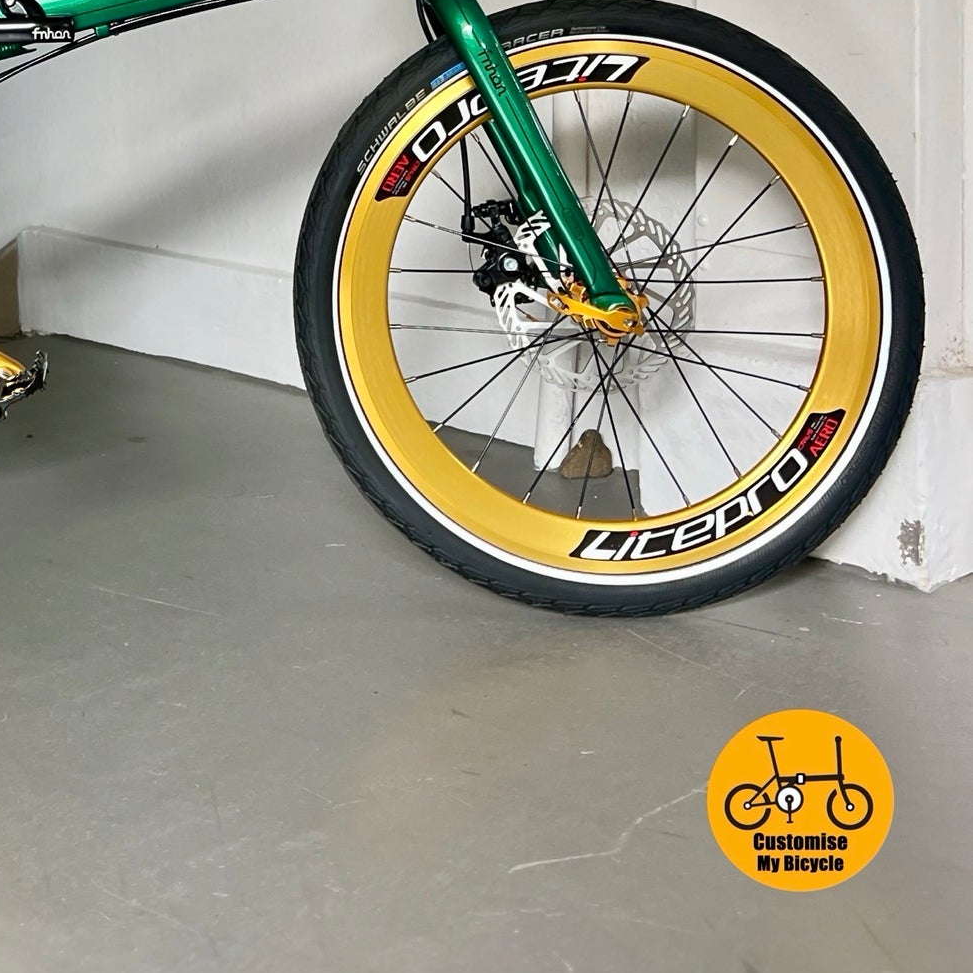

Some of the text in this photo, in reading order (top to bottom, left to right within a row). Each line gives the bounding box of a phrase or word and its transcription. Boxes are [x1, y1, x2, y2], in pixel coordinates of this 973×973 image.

[31, 26, 72, 40] fnhon
[356, 88, 426, 176] SCHWALBE
[382, 154, 409, 193] AERO
[809, 417, 839, 458] AERO
[580, 447, 809, 561] Litepro
